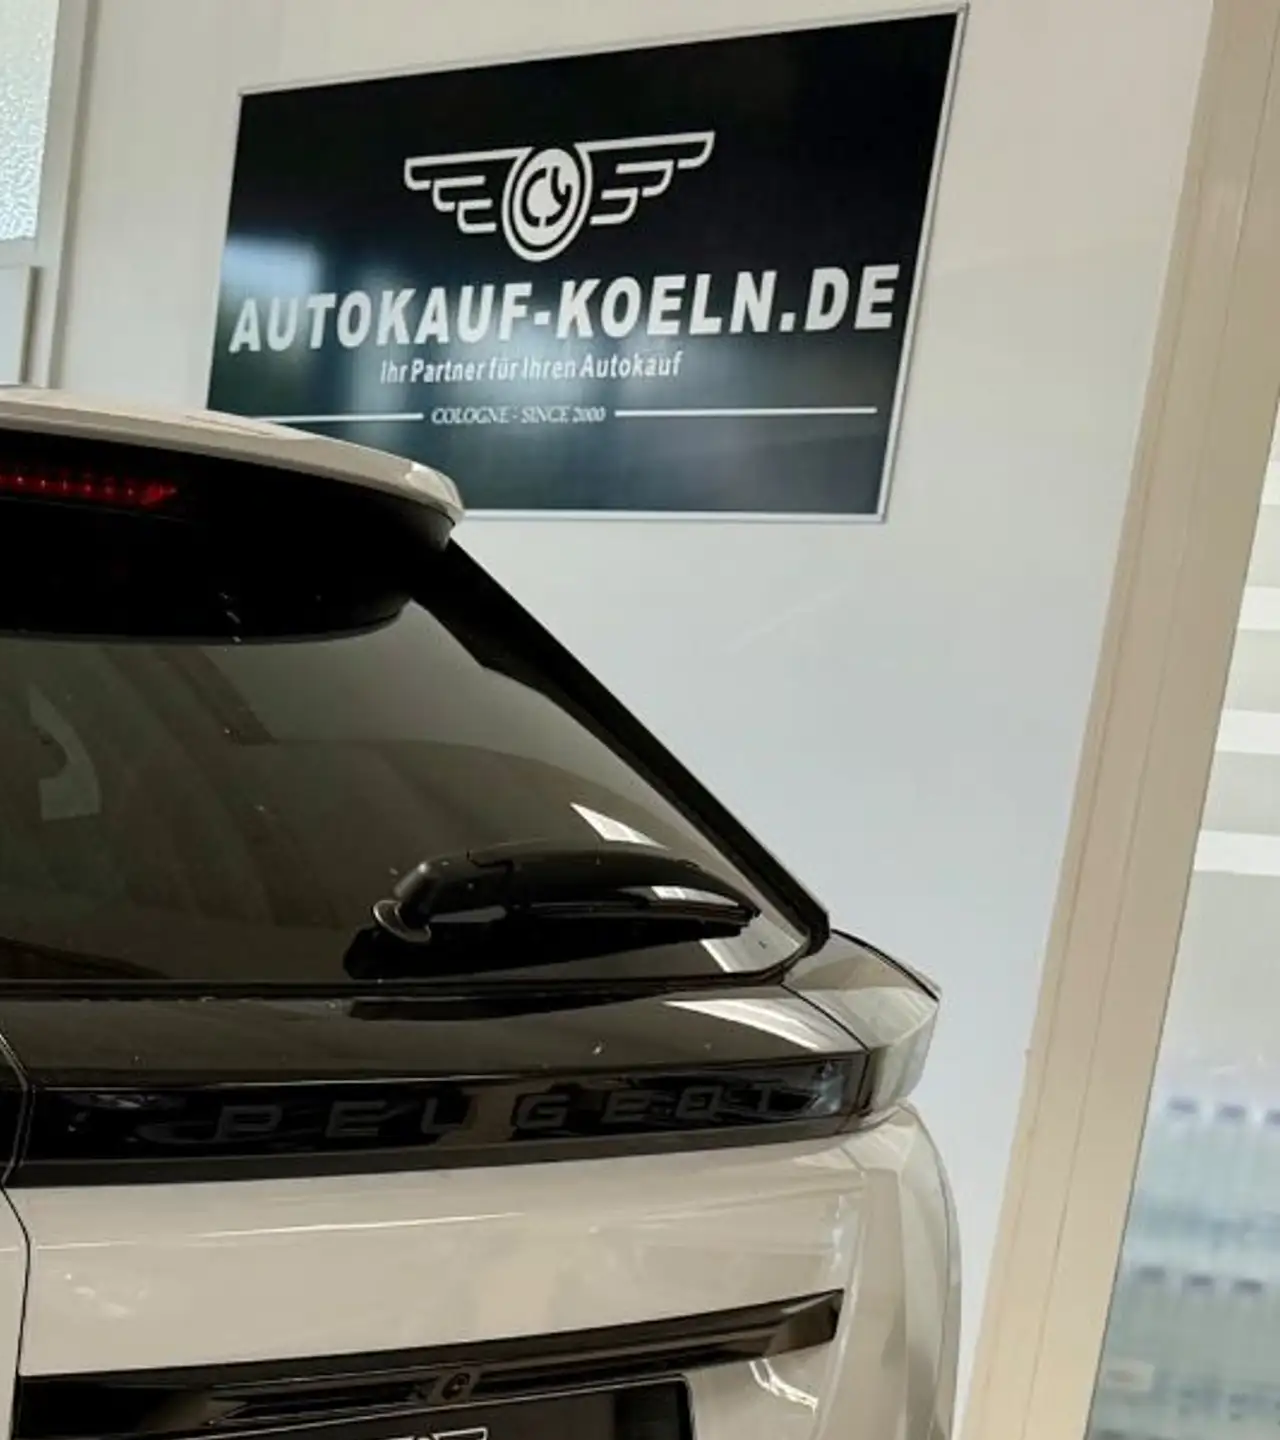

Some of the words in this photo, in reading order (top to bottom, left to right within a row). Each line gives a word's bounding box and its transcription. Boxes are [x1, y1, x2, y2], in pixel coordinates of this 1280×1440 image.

[229, 264, 901, 353] AUTOKAUF-KOELN.DE
[380, 359, 407, 384] Ihr
[410, 357, 484, 383] Partner
[488, 355, 519, 381] für
[520, 356, 576, 380] Ihren
[579, 350, 683, 379] Autokauf
[431, 404, 510, 425] COLOGNE
[520, 404, 570, 424] SINCE
[213, 1078, 785, 1141] PEUGEOT
